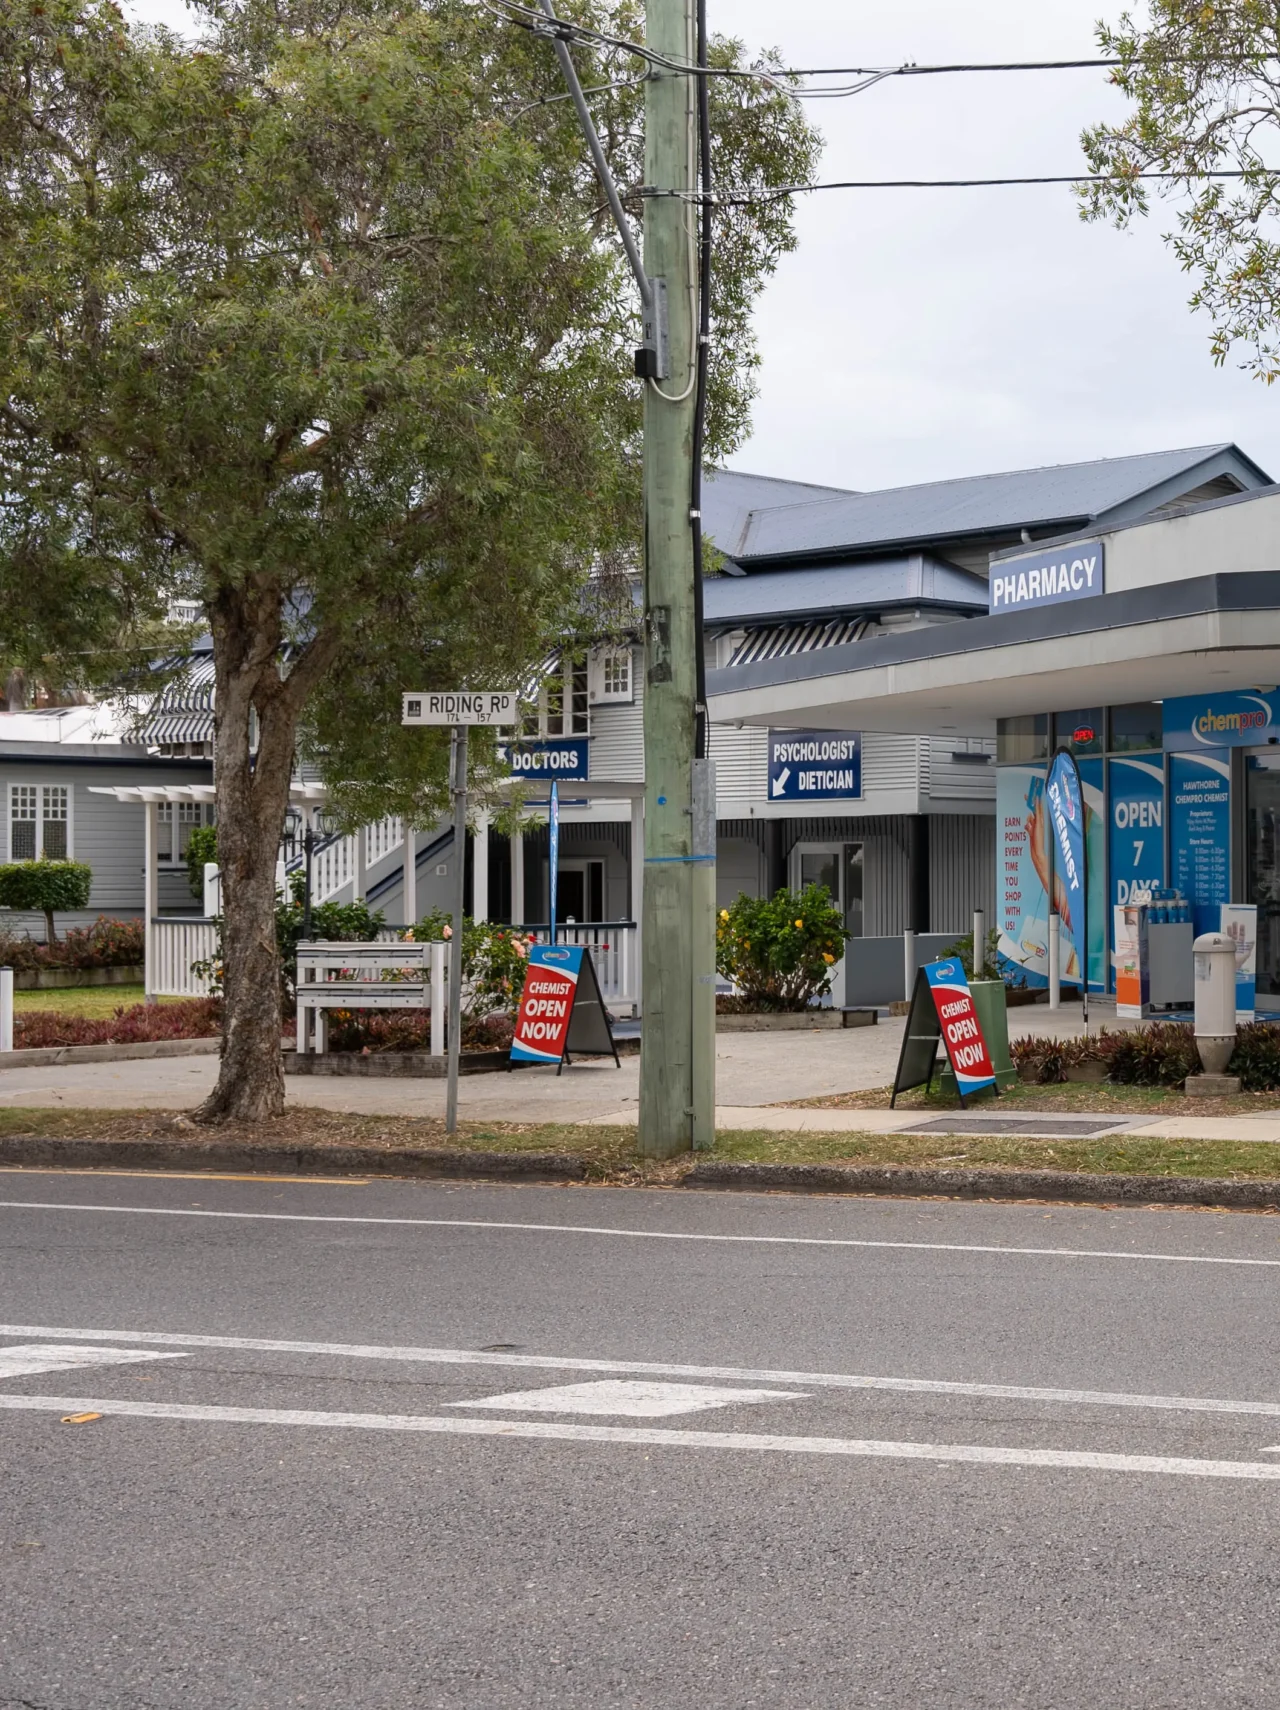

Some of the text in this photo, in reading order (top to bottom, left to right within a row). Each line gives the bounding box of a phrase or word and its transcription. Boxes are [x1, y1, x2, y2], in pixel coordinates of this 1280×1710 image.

[993, 557, 1096, 607] PHARMACY
[430, 696, 510, 713] RIDING RD
[476, 713, 492, 722] 157
[1199, 709, 1266, 736] chempro
[1073, 730, 1094, 741] OPEN
[774, 741, 855, 762] PSYCHOLOGIST
[512, 751, 579, 770] DOCTORS
[799, 770, 853, 790] DIETICIAN
[1183, 780, 1220, 790] HAWTHORNE
[1175, 793, 1228, 804] CHEMPRO CHEMIST
[1004, 817, 1021, 827] EARN
[1115, 801, 1162, 828] OPEN
[1004, 831, 1027, 842] POINTS
[1048, 782, 1080, 892] CHEMIST
[1004, 847, 1023, 857] EVERY
[1133, 841, 1144, 866] 7
[1004, 862, 1019, 872] TIME
[1004, 877, 1019, 887] YOU
[1004, 891, 1022, 902] SHOP
[1004, 906, 1021, 916] WITH
[1004, 921, 1015, 931] US!
[529, 982, 571, 995] CHEMIST
[525, 999, 567, 1017] OPEN
[941, 999, 970, 1019] CHEMIST
[520, 1022, 562, 1040] NOW
[947, 1018, 978, 1044] OPEN
[954, 1042, 984, 1069] NOW
